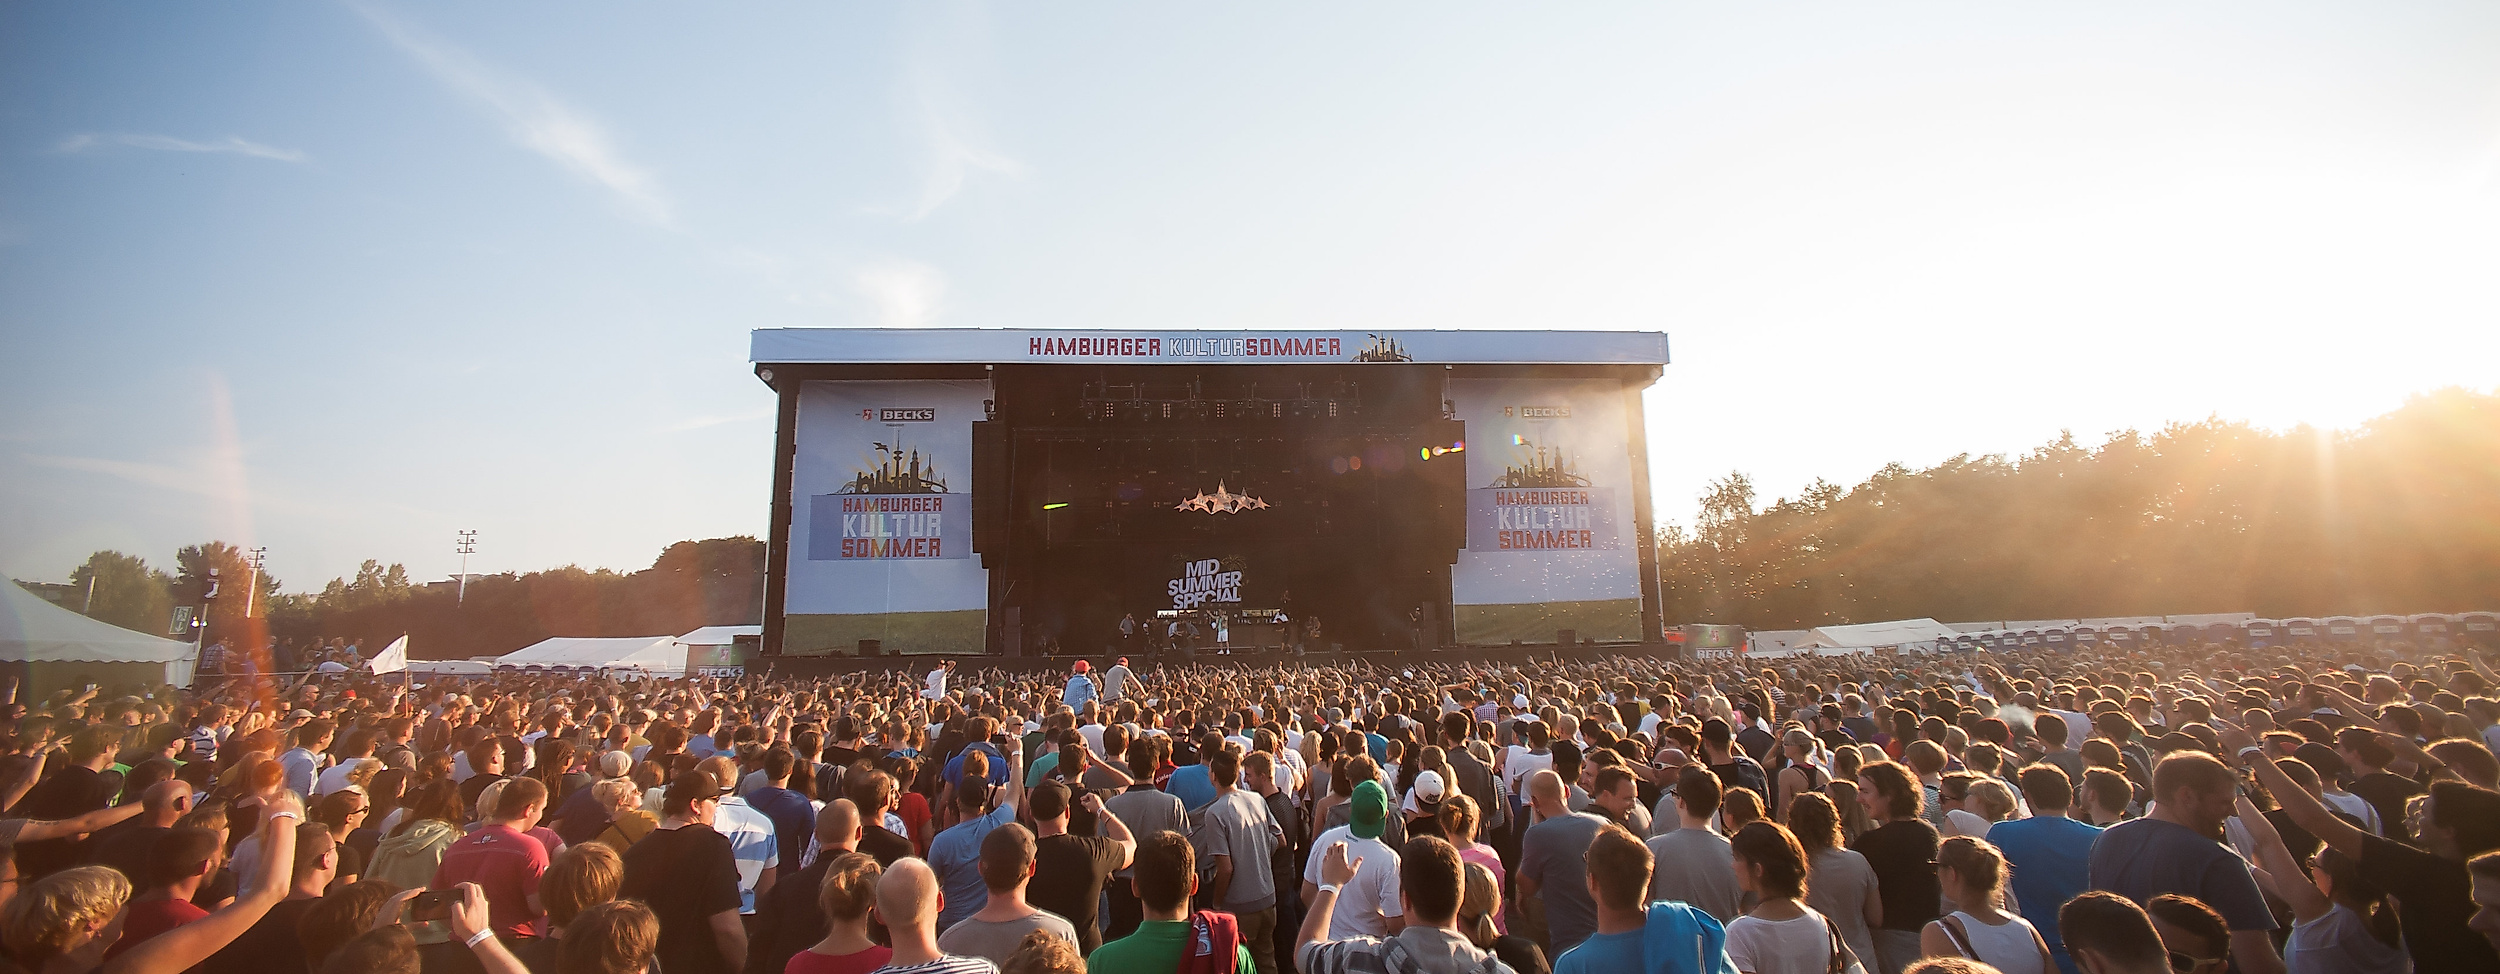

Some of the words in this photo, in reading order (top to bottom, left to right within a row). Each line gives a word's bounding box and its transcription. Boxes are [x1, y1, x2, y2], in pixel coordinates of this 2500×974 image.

[1028, 337, 1161, 356] HAMBURGER
[882, 410, 933, 420] BECK'S
[842, 497, 942, 512] HAMBURGER
[1496, 491, 1589, 505] HAMBURGER
[842, 513, 941, 538] KULTUR
[1498, 506, 1590, 530] KULTUR
[841, 538, 941, 558] SOMMER
[1499, 530, 1592, 549] SOMMER
[1186, 559, 1220, 578] MID
[1167, 570, 1242, 596] SUMMER
[1172, 587, 1241, 609] SPECIAL
